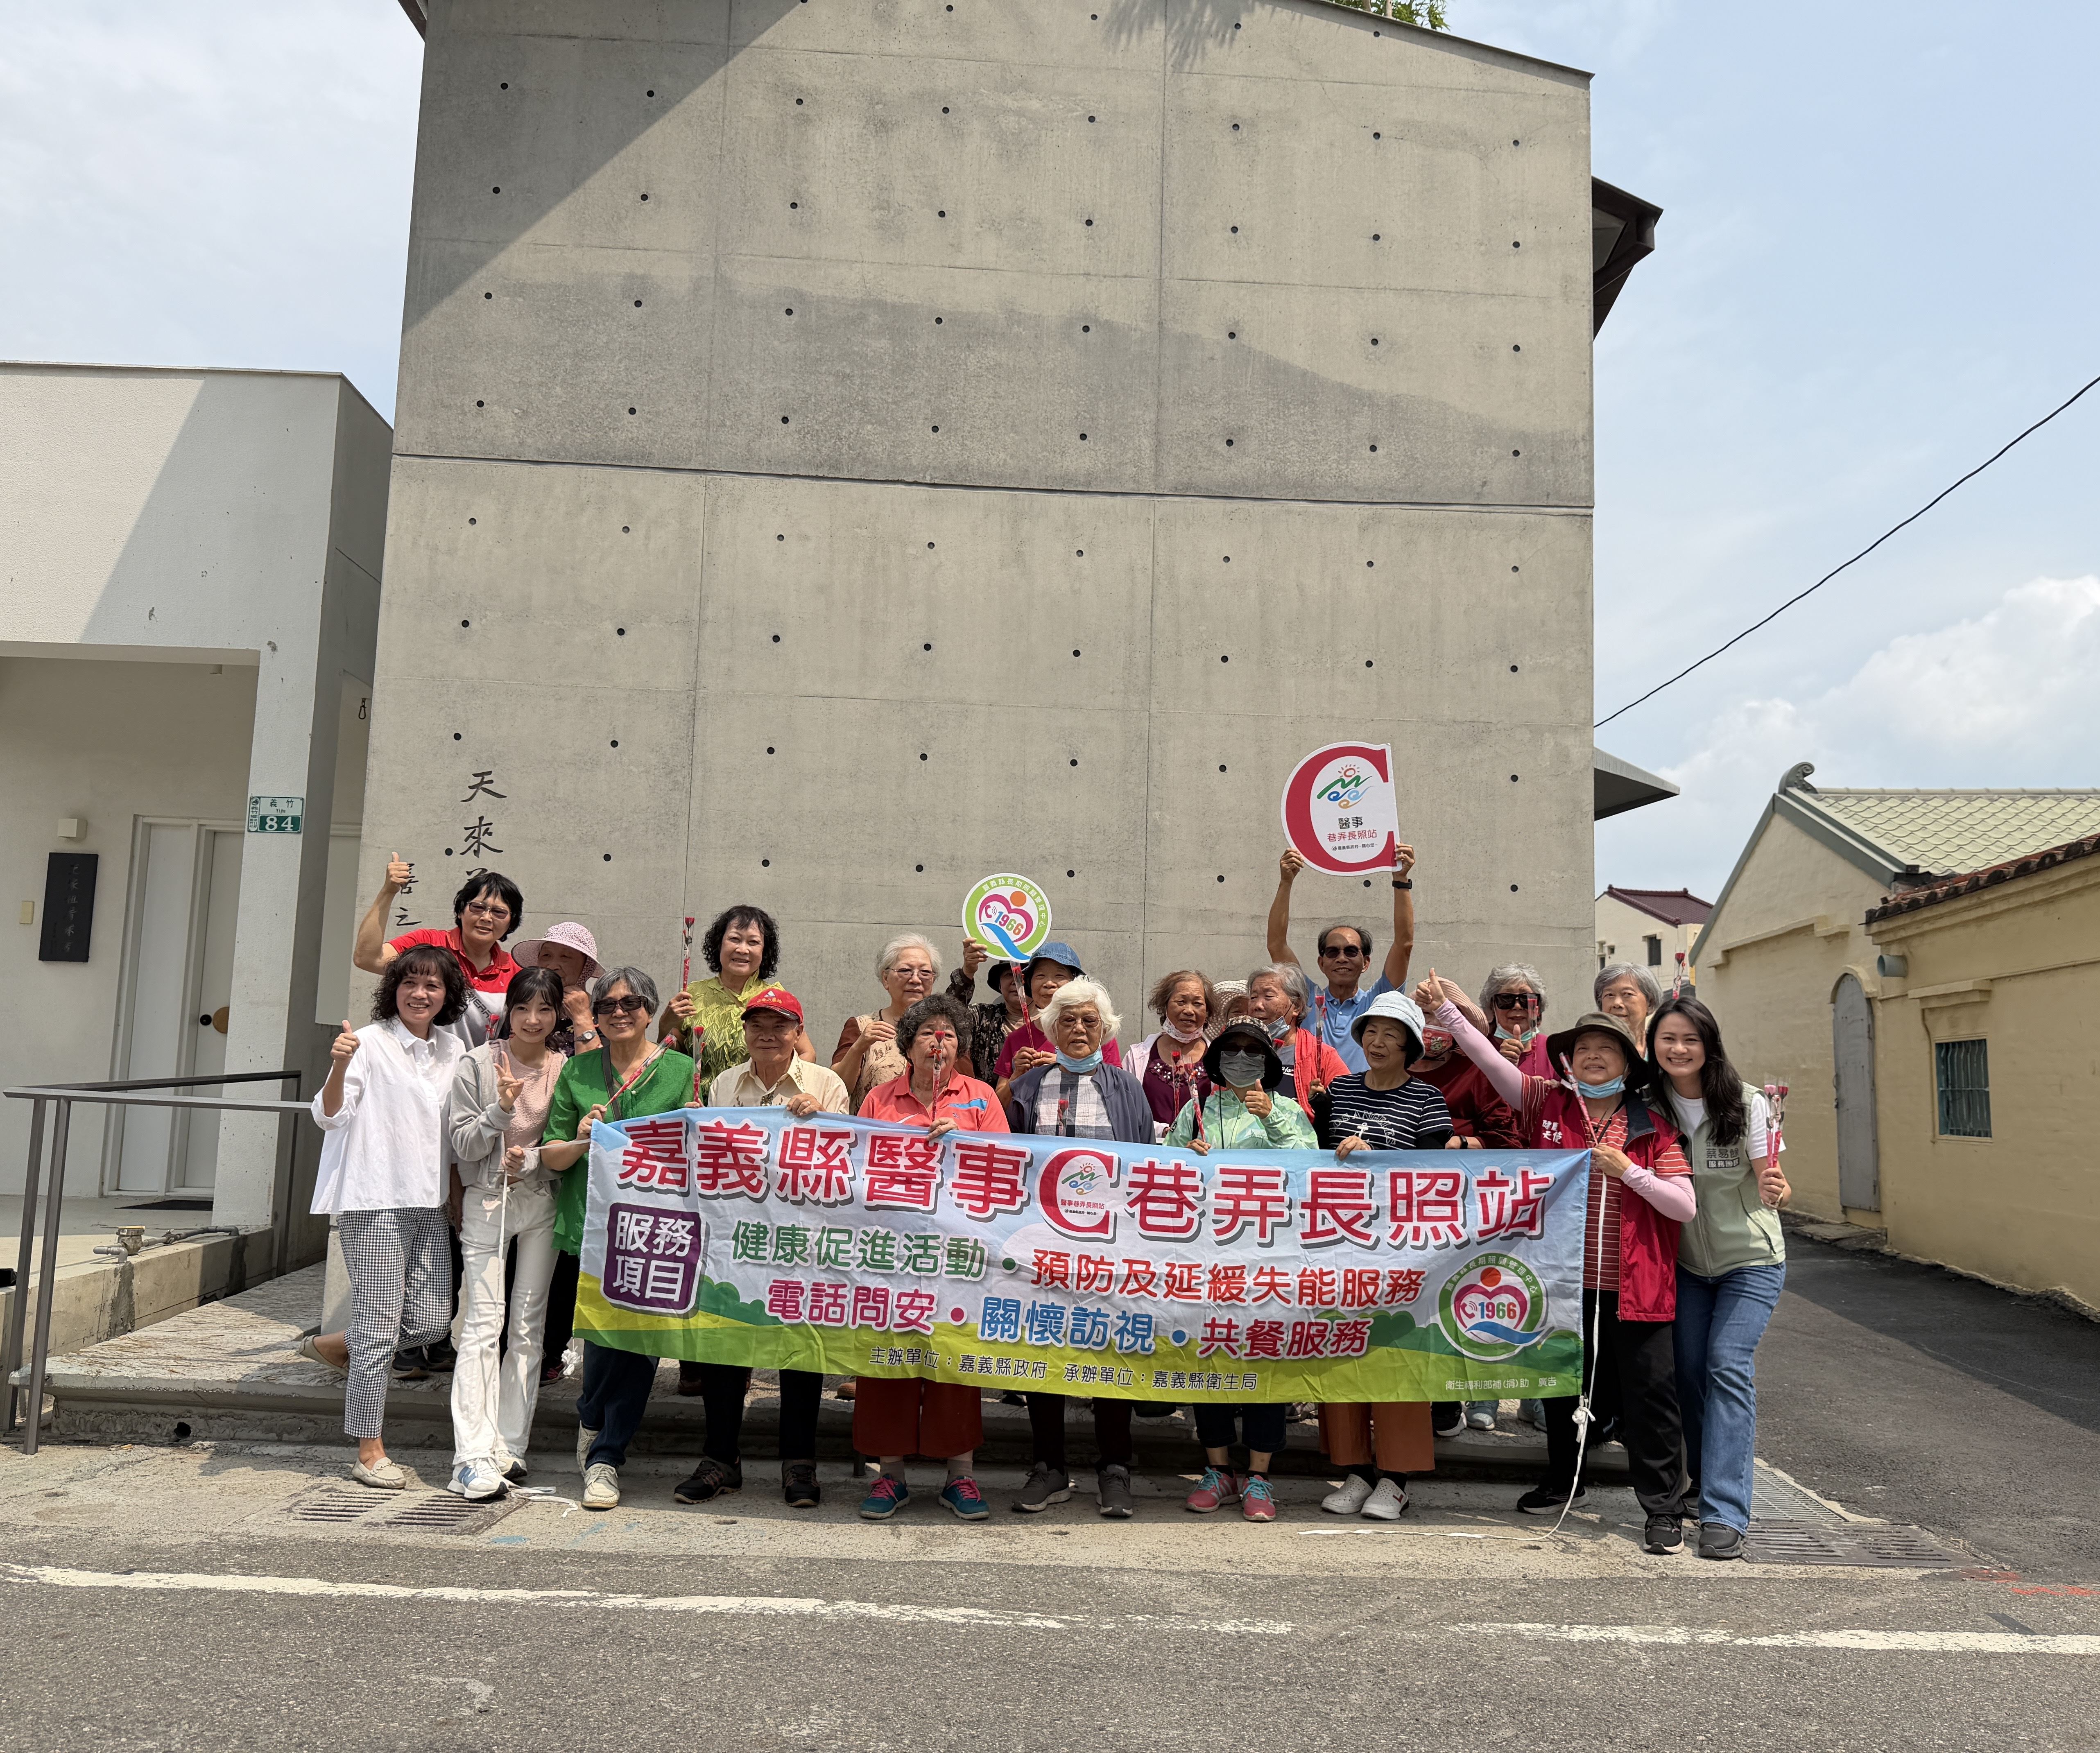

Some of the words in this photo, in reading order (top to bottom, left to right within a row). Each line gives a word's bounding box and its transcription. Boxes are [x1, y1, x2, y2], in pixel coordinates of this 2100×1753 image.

[270, 798, 294, 808] 義竹
[265, 816, 294, 831] 84
[1338, 816, 1363, 829] 醫事
[1327, 829, 1377, 842] 巷弄長照站
[994, 912, 1024, 936] 1966
[1542, 1131, 1563, 1144] 天使
[614, 1210, 693, 1258] 服務
[733, 1221, 983, 1276] 健康促進活動
[1032, 1249, 1426, 1307] 預防及延緩失能服務
[613, 1257, 686, 1303] 項目
[768, 1280, 935, 1331] 電話問安
[981, 1297, 1153, 1352] 關懷訪視
[1200, 1317, 1369, 1356] 共餐服務
[1478, 1301, 1517, 1319] 1966
[1538, 1376, 1557, 1387] 廣告
